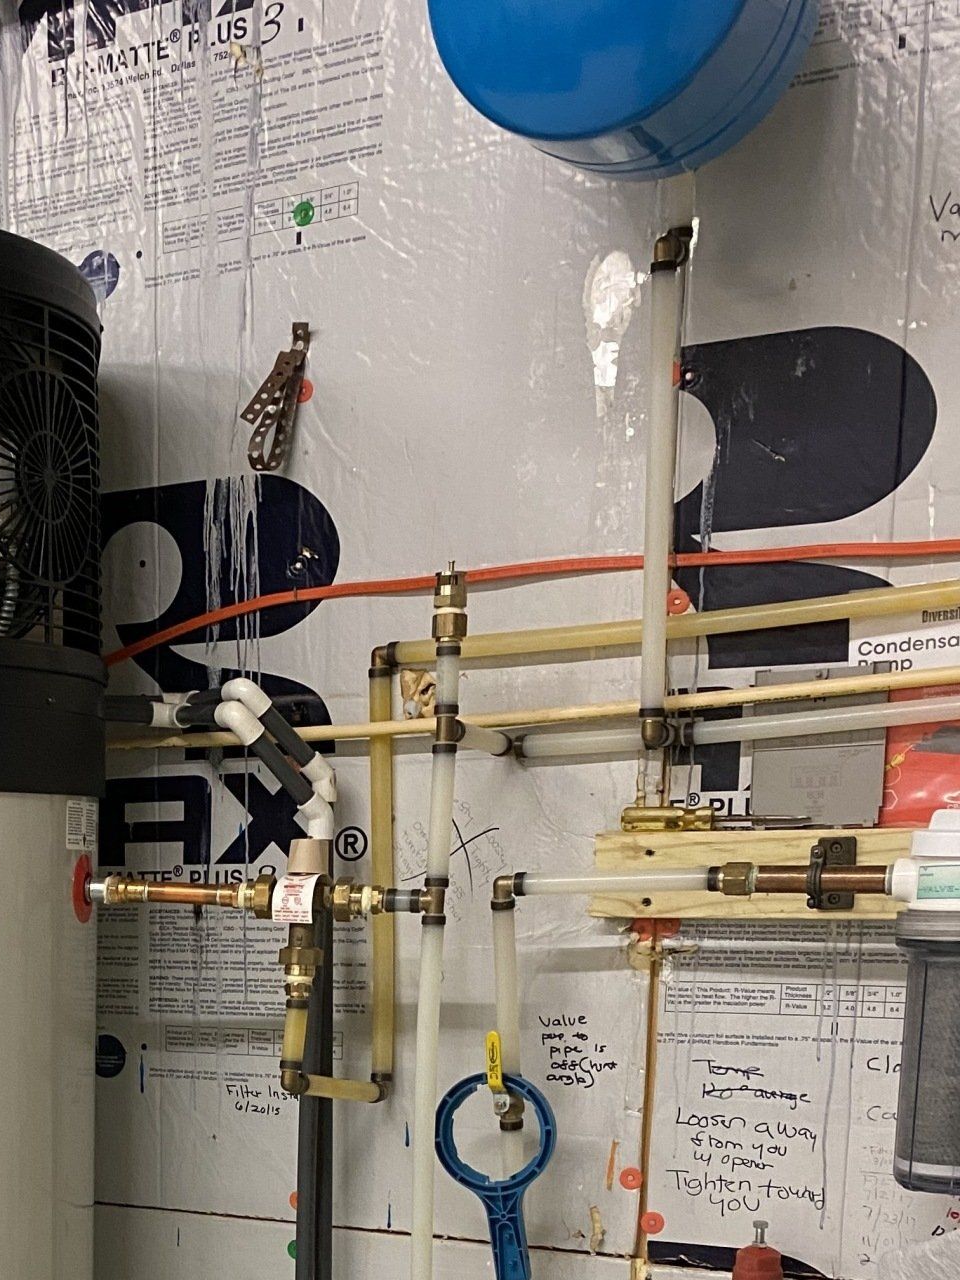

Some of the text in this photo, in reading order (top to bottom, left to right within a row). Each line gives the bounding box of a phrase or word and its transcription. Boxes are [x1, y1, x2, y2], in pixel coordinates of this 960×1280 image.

[226, 1084, 262, 1098] Filter
[690, 1130, 743, 1150] from
[665, 1169, 751, 1197] Tighten
